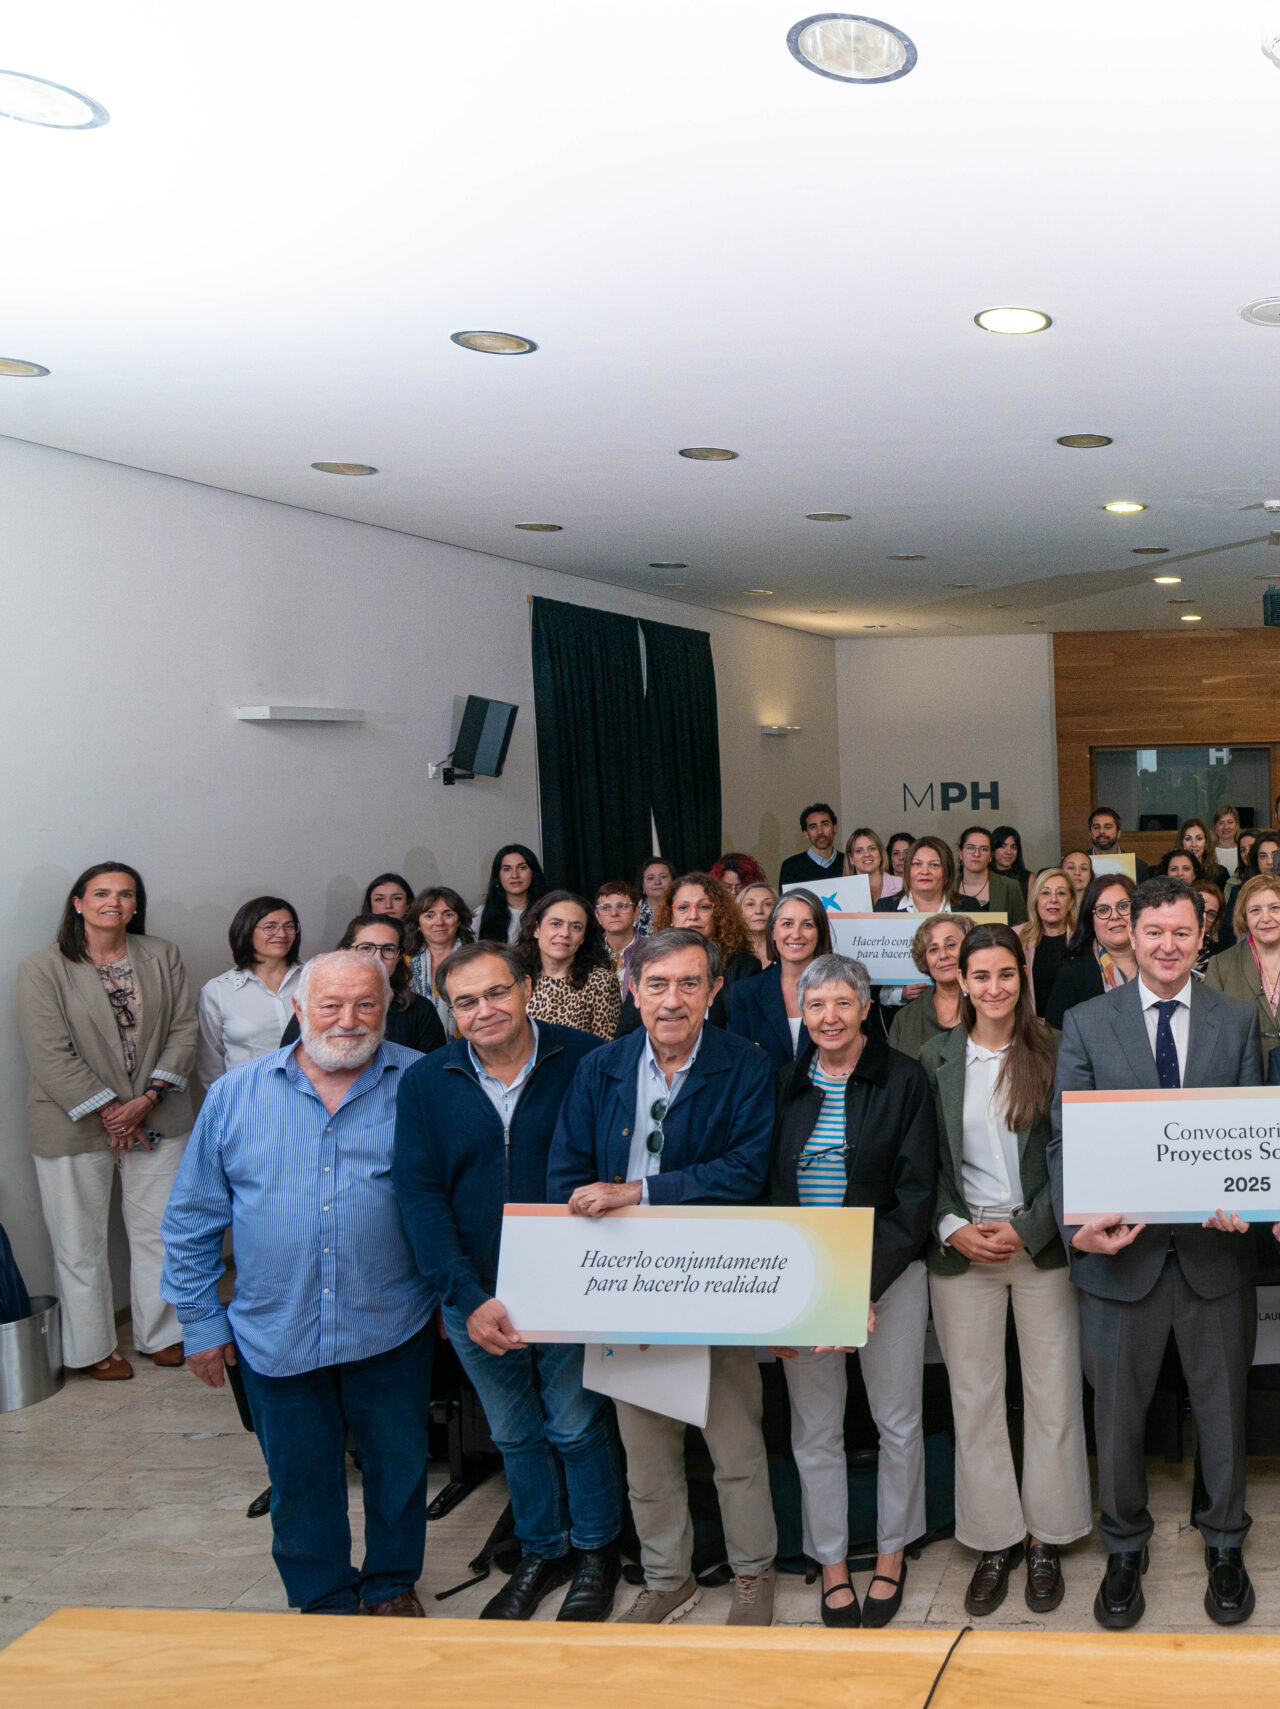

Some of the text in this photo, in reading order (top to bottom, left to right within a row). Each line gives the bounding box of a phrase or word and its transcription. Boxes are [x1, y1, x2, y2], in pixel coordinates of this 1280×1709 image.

[903, 781, 1000, 812] MPH
[852, 935, 891, 946] Hacerlo
[856, 949, 913, 960] para hacerl
[1156, 1143, 1252, 1166] Proyectos
[1223, 1176, 1271, 1192] 2025
[580, 1250, 788, 1273] Hacerlo conjuntamente
[584, 1274, 781, 1296] para hacerlo realidad
